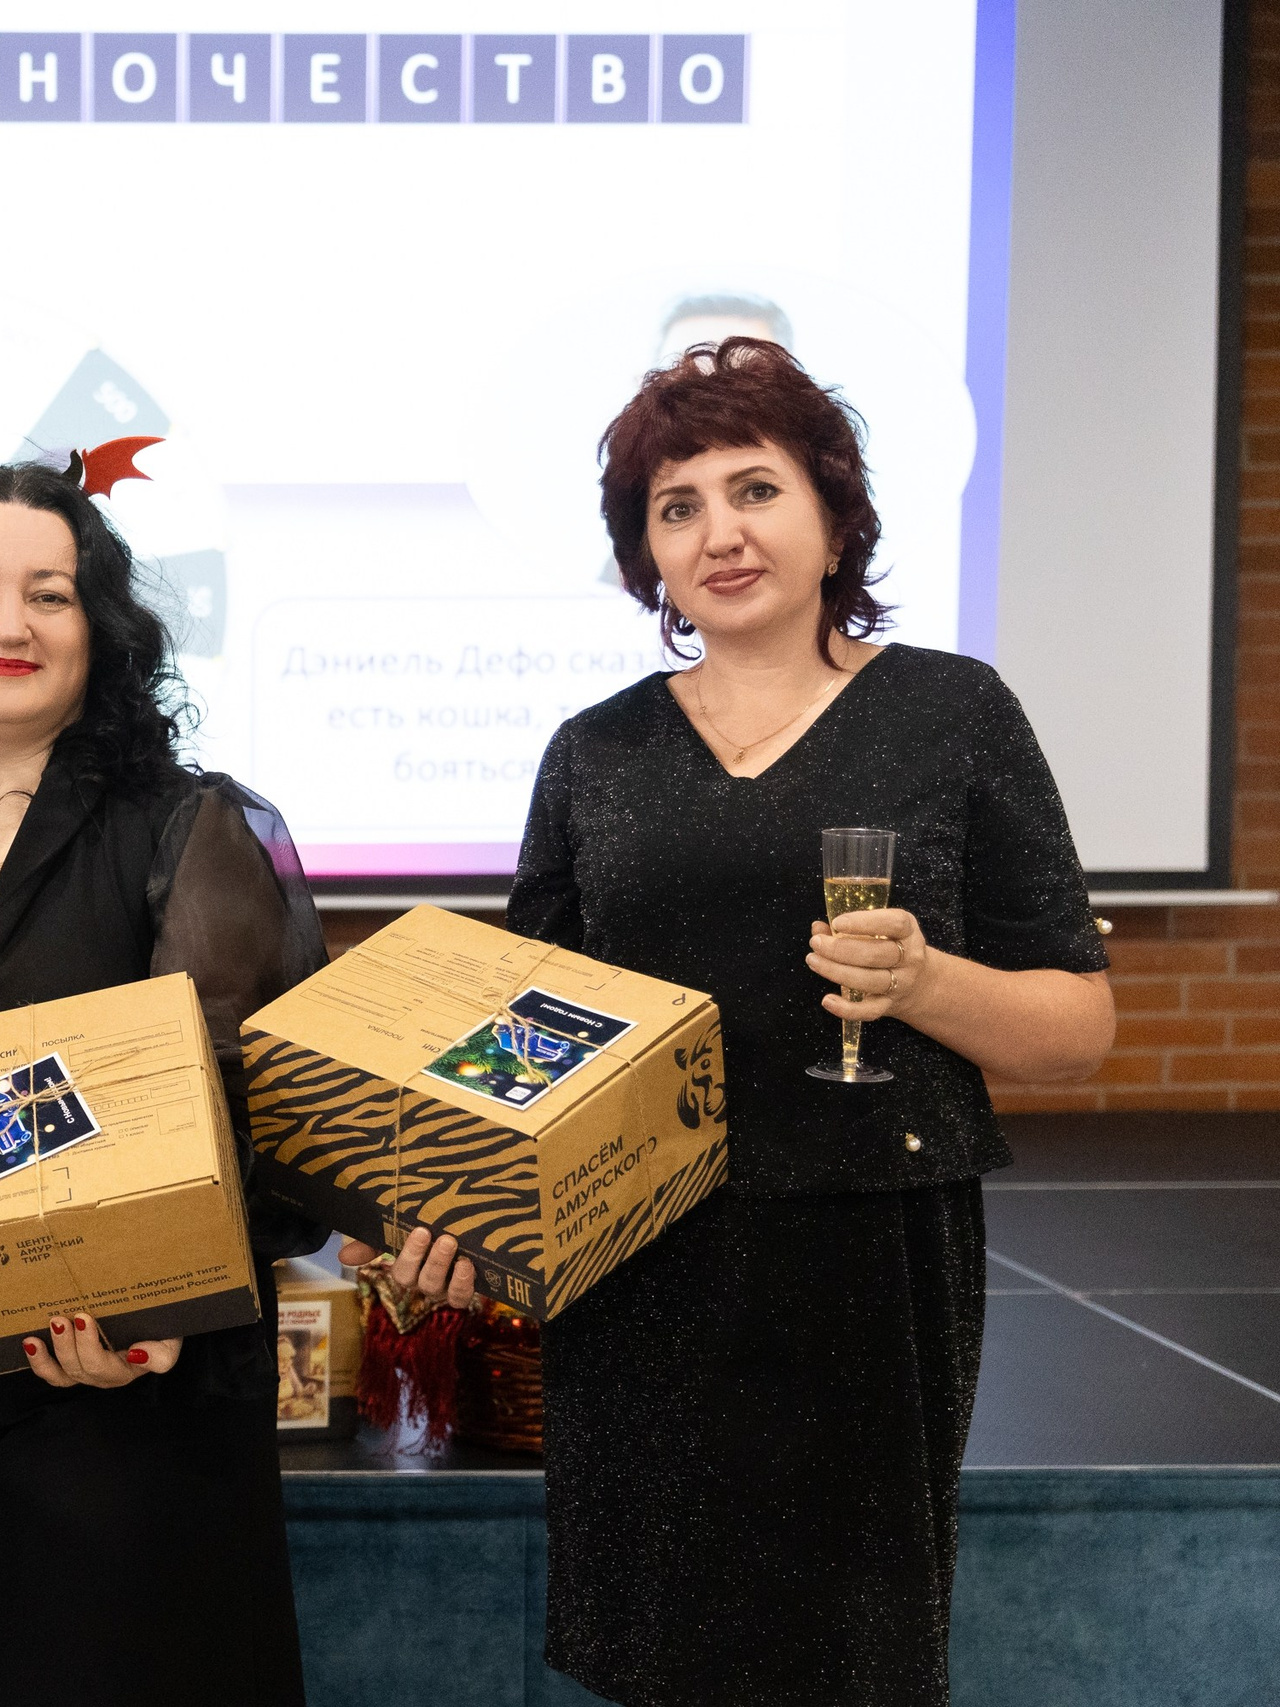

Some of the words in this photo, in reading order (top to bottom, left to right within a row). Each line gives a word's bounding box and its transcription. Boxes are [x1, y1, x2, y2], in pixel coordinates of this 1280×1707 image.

[92, 379, 138, 424] 500
[281, 645, 443, 681] Дэниель
[455, 645, 556, 681] Дефо
[327, 705, 404, 729] есть
[417, 705, 543, 732] кошка,
[393, 750, 536, 783] бояться
[567, 1012, 595, 1026] Новым
[41, 1033, 85, 1048] ПОСЫЛКА
[552, 1135, 623, 1199] СПАСЁМ
[554, 1136, 657, 1227] АМУРСКОГО
[555, 1200, 609, 1248] ТИГРА
[21, 1253, 51, 1265] ТИГР
[0, 1304, 36, 1318] Почта
[38, 1295, 80, 1310] России
[91, 1286, 128, 1302] Центр
[130, 1270, 194, 1291] «Амурский
[195, 1263, 228, 1277] тигр»
[132, 1285, 185, 1302] природы
[186, 1274, 232, 1289] России.
